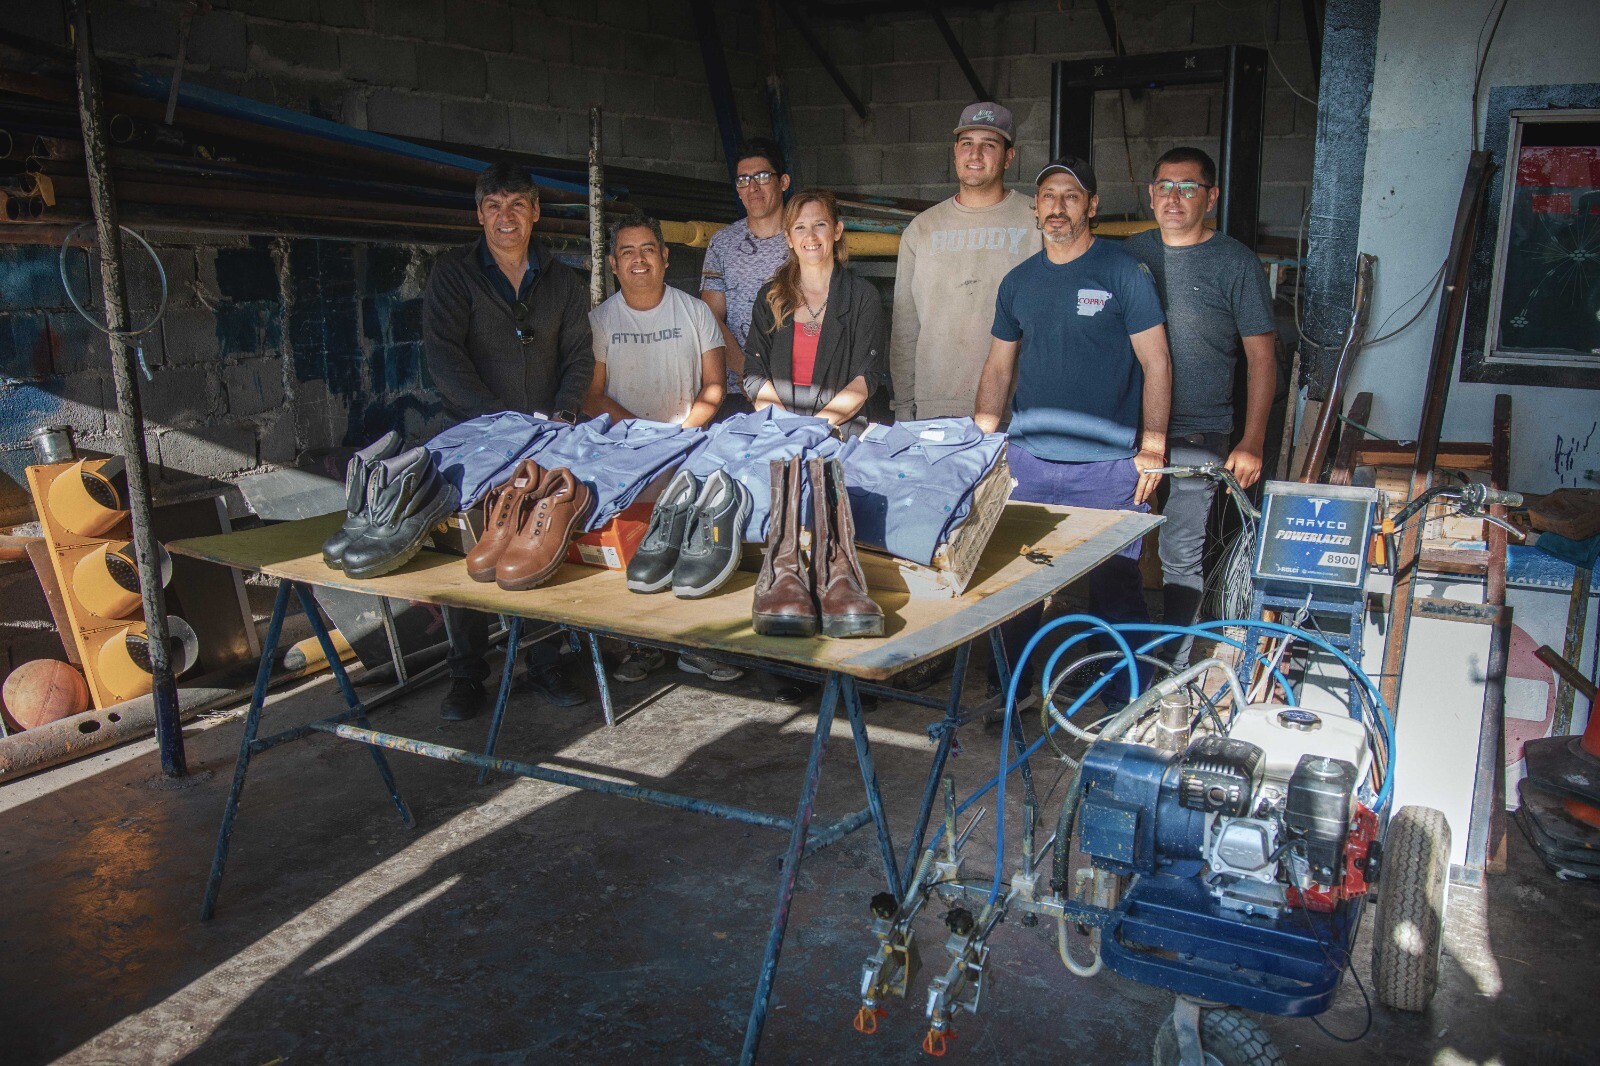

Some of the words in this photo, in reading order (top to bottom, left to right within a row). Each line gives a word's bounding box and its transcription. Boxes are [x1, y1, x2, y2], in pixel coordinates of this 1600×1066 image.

[611, 327, 682, 344] ATTITUDE
[1286, 517, 1347, 530] TRAYCO
[1327, 554, 1356, 566] 8900
